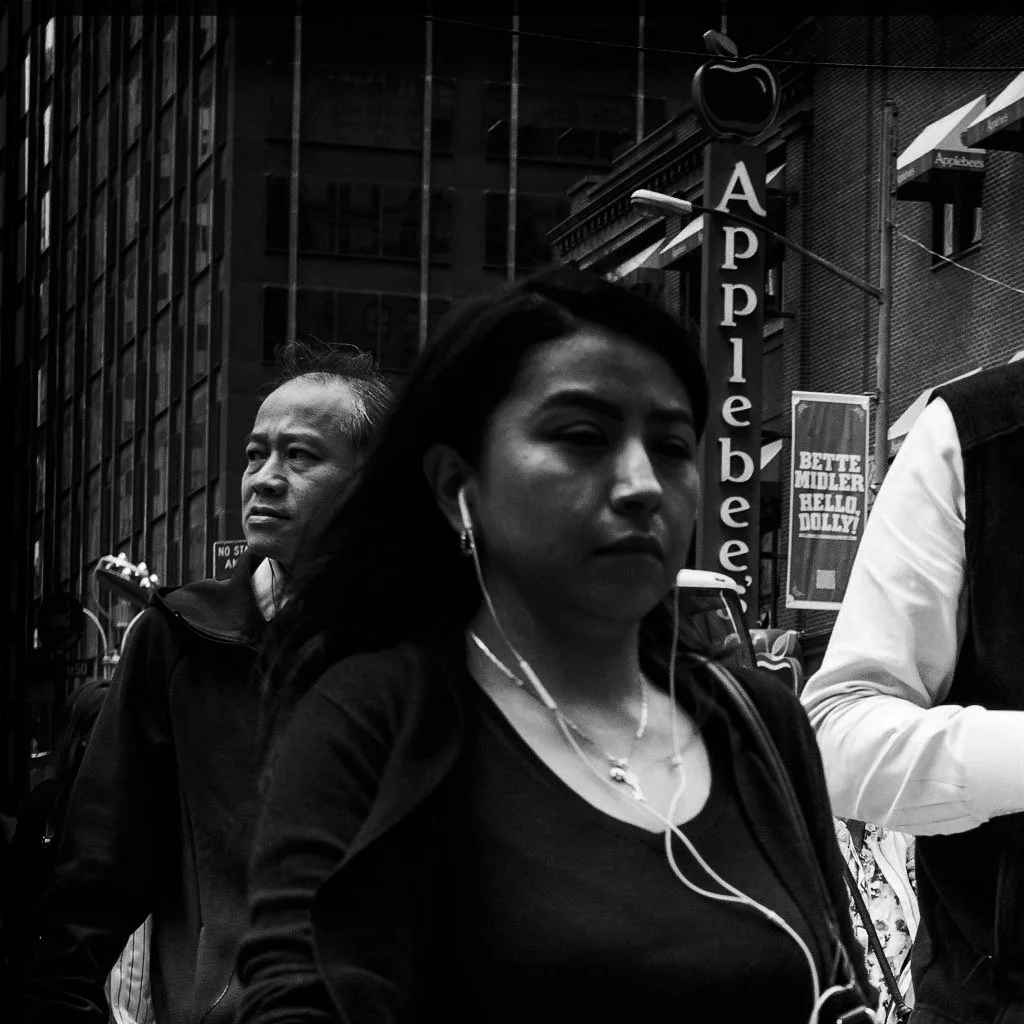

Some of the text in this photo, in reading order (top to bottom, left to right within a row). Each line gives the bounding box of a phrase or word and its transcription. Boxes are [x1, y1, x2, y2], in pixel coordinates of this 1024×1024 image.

[714, 160, 767, 613] Applebee'
[799, 450, 861, 473] BETTE
[794, 470, 865, 493] MIDLER
[799, 493, 861, 516] HELLO,
[798, 512, 860, 535] DOLLY!
[217, 545, 230, 557] NO
